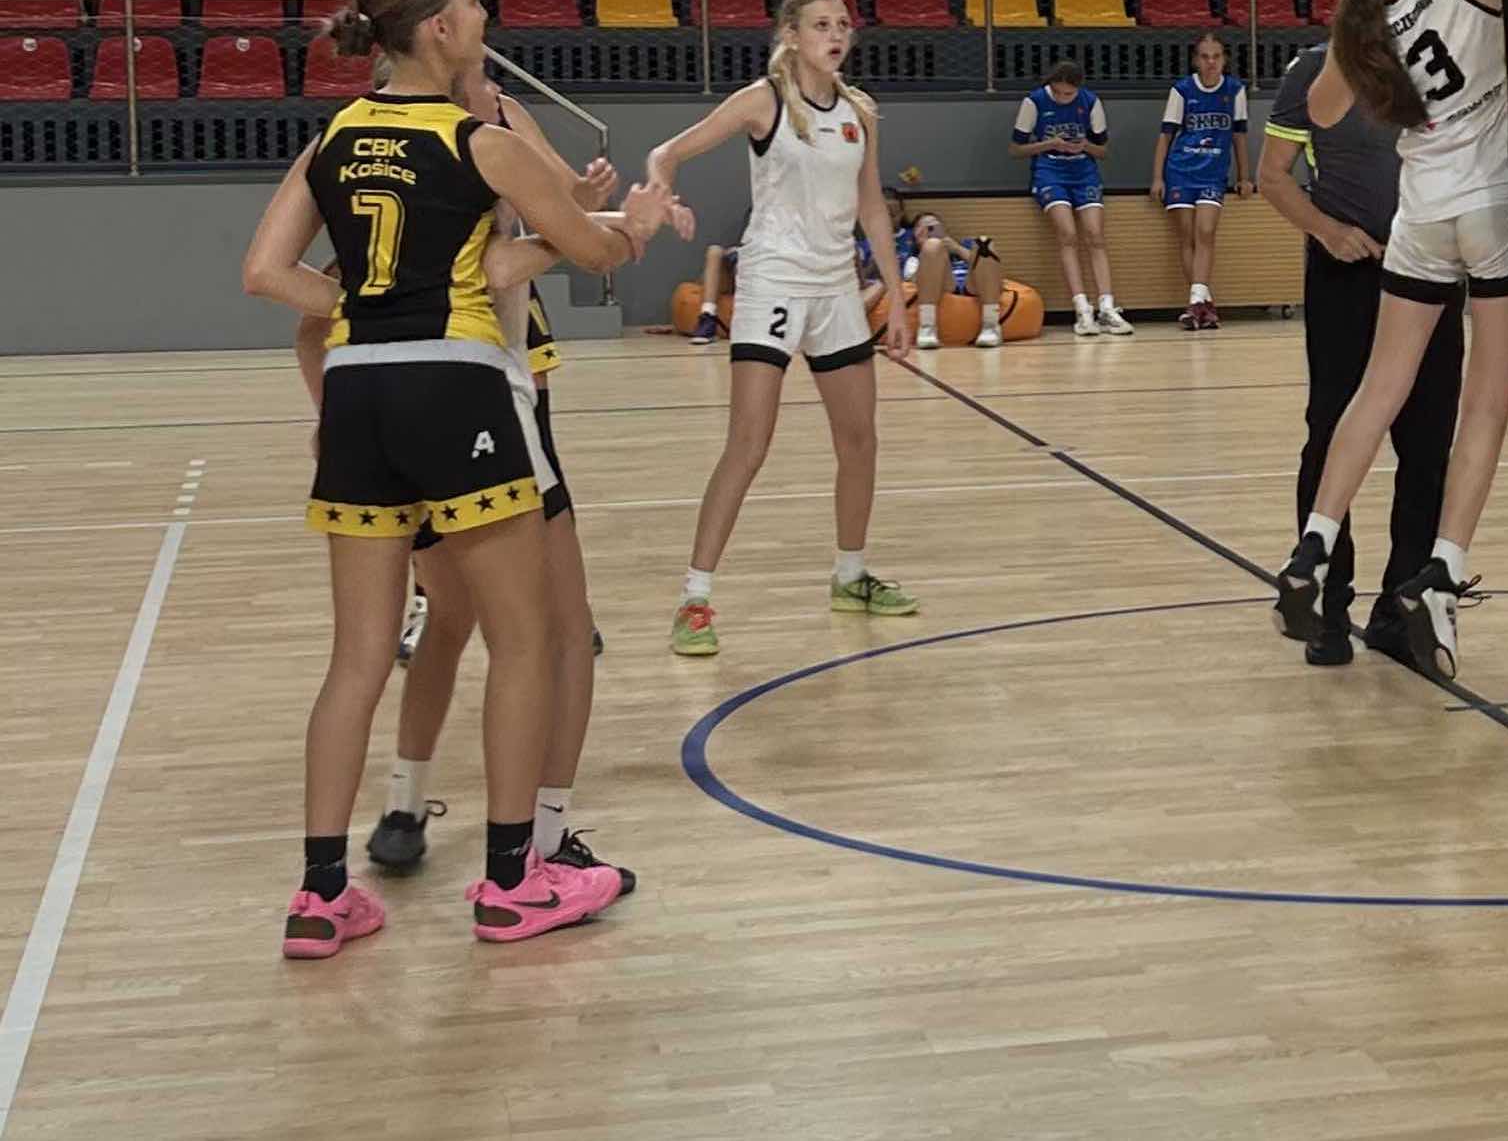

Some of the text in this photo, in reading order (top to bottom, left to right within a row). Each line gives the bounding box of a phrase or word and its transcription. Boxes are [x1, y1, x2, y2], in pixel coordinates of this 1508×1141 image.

[1405, 29, 1466, 101] 3
[352, 138, 411, 158] CBK
[351, 188, 406, 296] 7
[768, 307, 788, 339] 2
